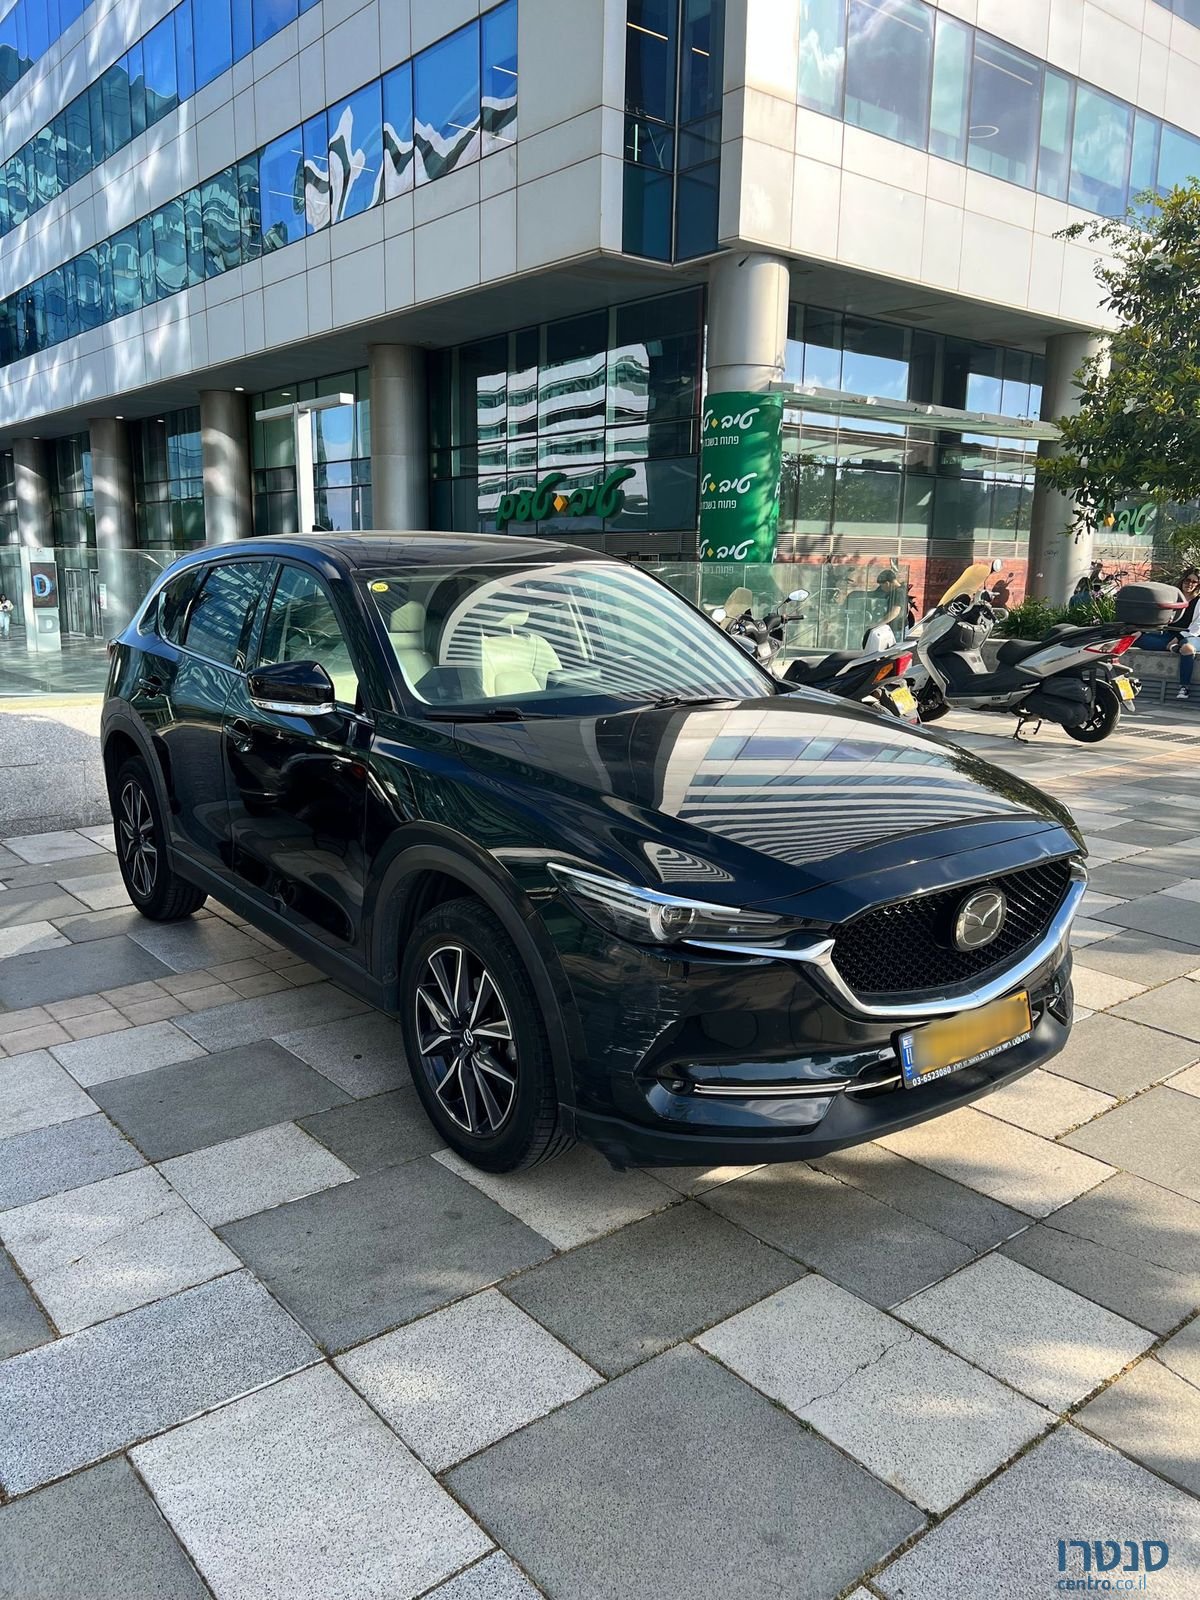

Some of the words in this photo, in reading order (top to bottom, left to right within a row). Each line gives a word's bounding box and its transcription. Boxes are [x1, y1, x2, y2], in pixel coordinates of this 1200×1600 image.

[721, 408, 760, 430] טיב
[719, 435, 739, 445] פתוח
[569, 468, 636, 518] טיב
[719, 473, 757, 494] טיב
[496, 472, 567, 530] טעם
[717, 499, 737, 509] פתוח
[717, 539, 754, 560] טיב
[912, 1065, 952, 1087] 03-6523080
